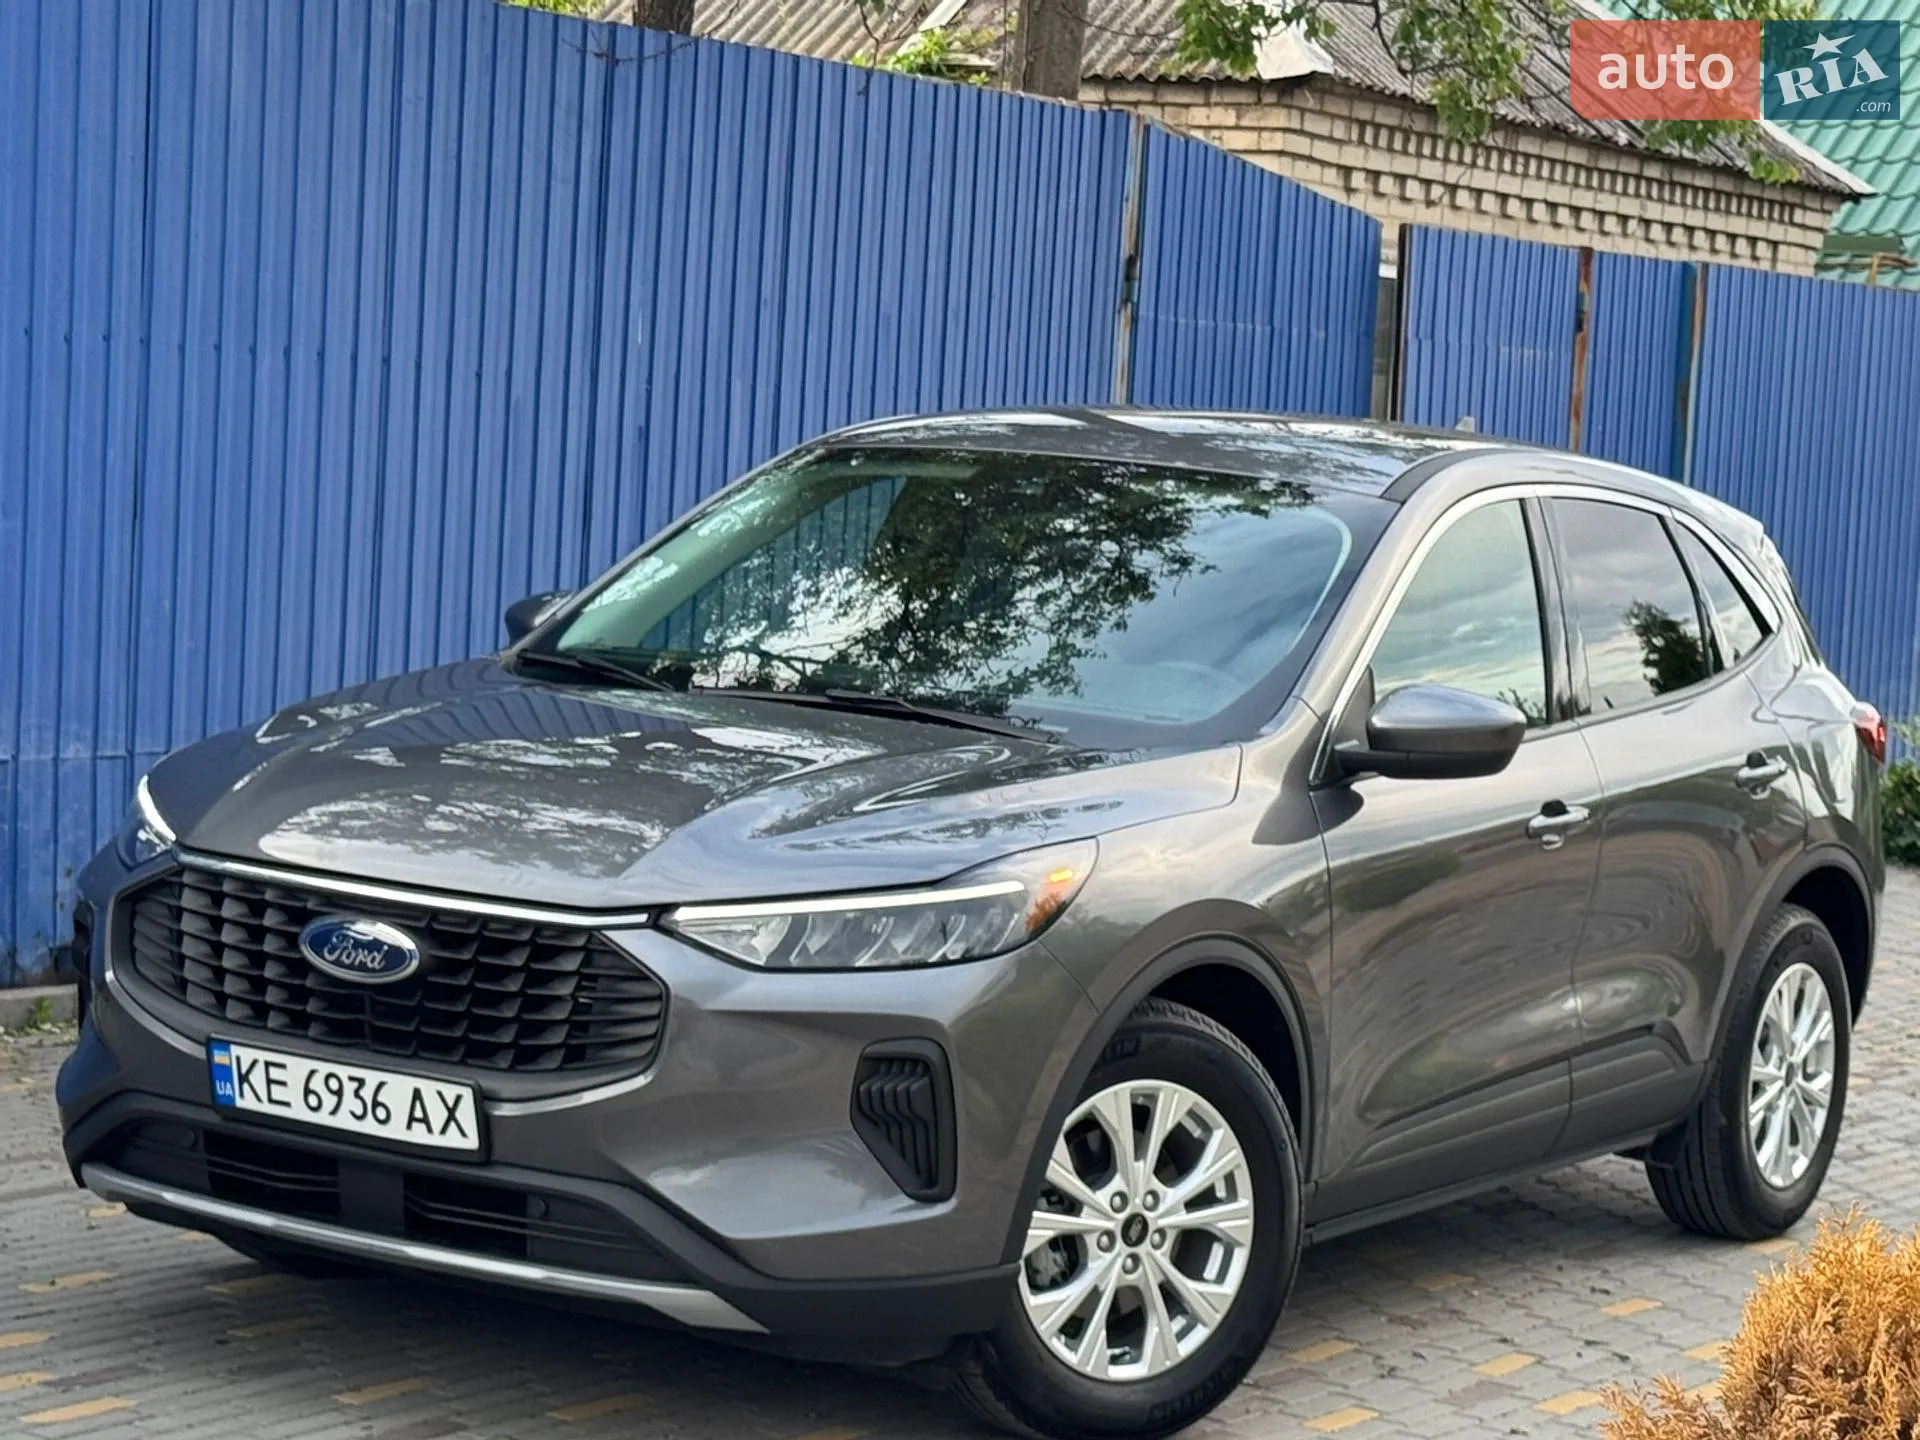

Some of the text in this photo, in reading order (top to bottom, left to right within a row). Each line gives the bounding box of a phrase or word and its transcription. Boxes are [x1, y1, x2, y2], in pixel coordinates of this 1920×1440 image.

[323, 929, 388, 970] Ford
[215, 1080, 234, 1098] UA
[235, 1055, 469, 1139] KE 6936 AX
